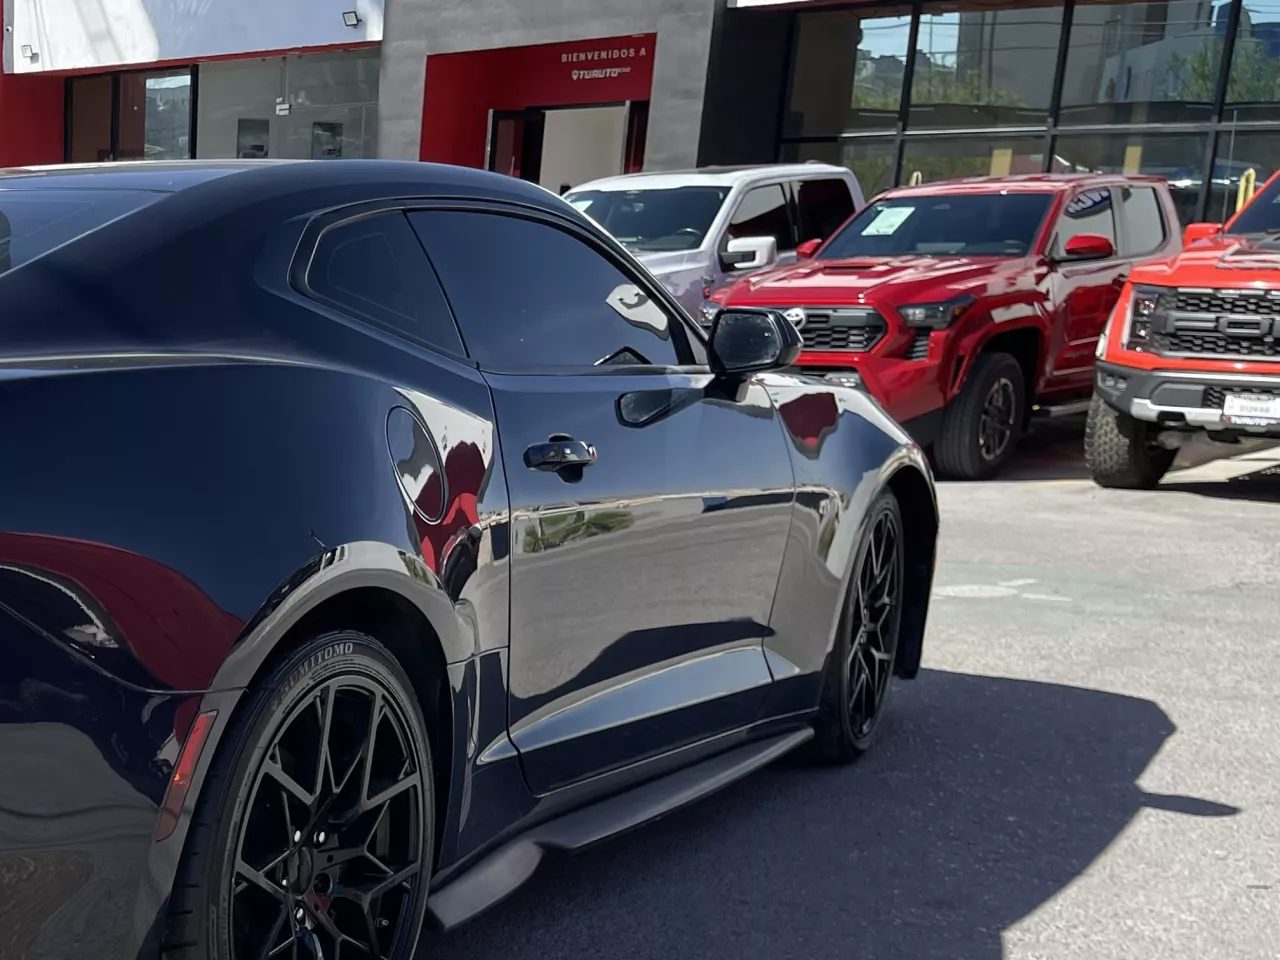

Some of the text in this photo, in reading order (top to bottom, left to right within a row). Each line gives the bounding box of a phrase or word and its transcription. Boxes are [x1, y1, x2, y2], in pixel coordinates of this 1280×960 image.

[561, 47, 646, 63] BIENVENIDOS A
[280, 642, 354, 699] SUMITOMO
